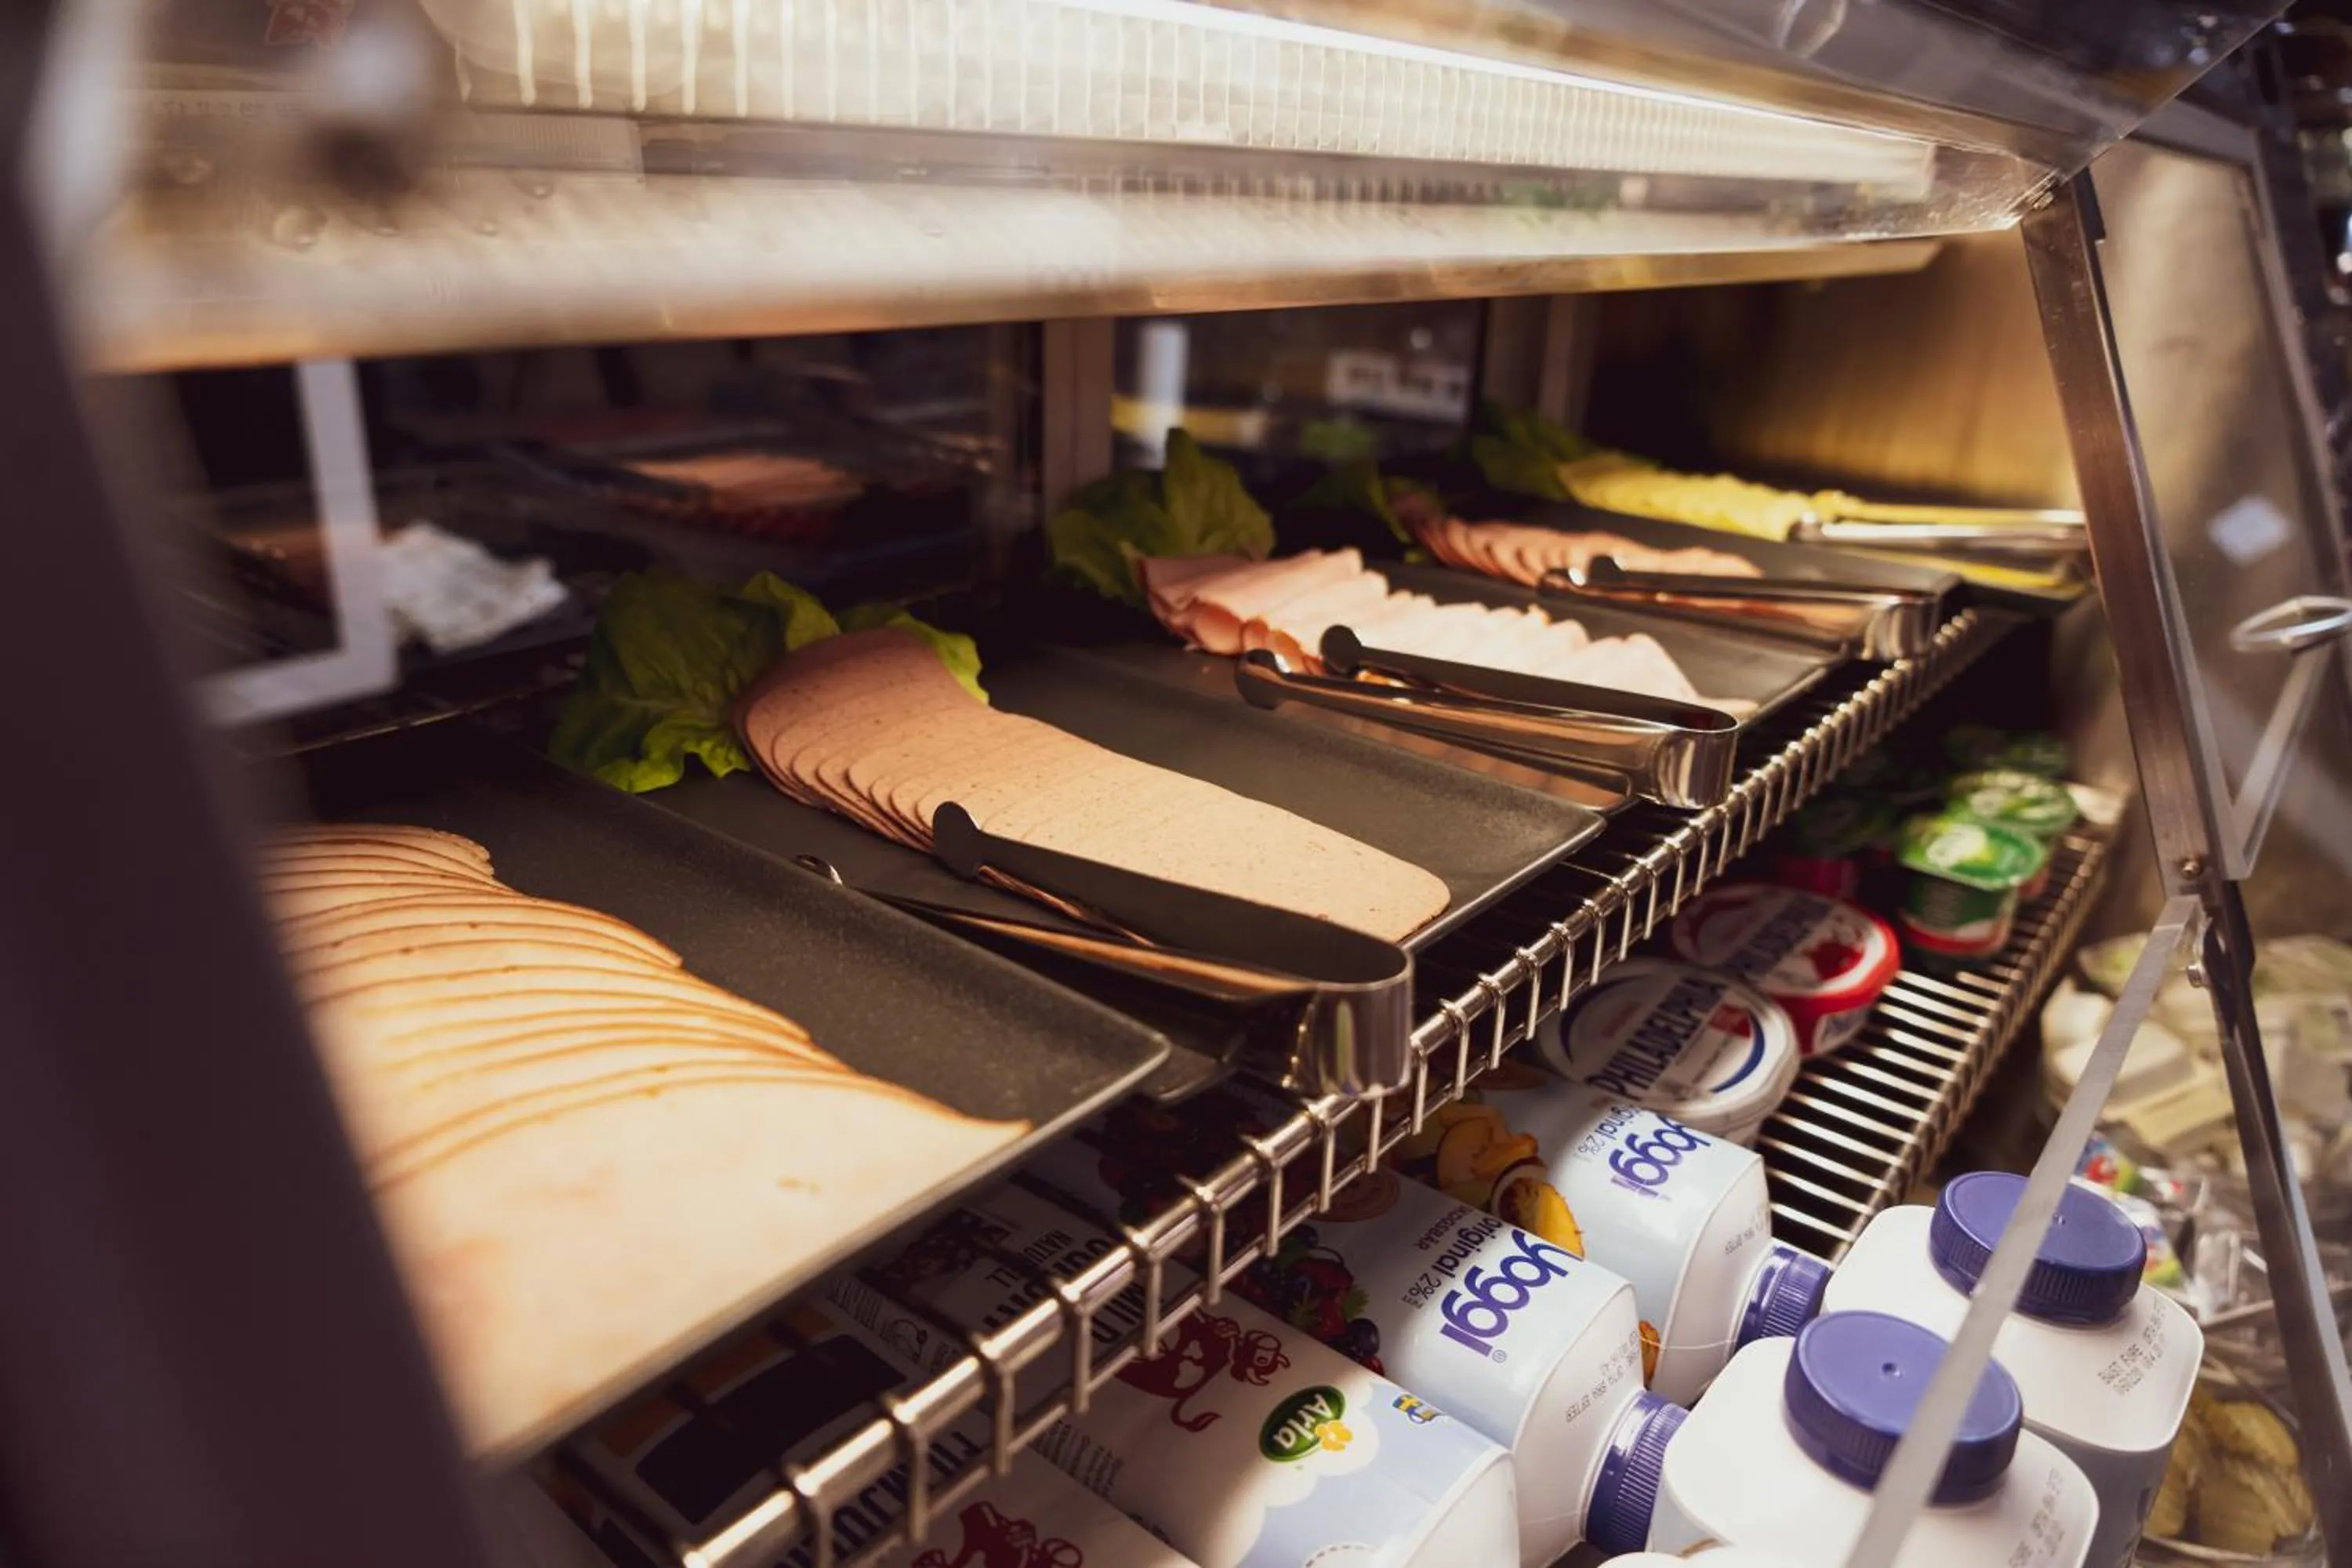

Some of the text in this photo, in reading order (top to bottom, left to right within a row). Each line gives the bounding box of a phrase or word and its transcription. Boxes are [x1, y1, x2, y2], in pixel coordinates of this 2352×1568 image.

[1431, 1216, 1503, 1279] original
[1408, 1273, 1442, 1300] 2%
[1439, 1229, 1584, 1360] yoggi
[1272, 1393, 1334, 1449] Arla
